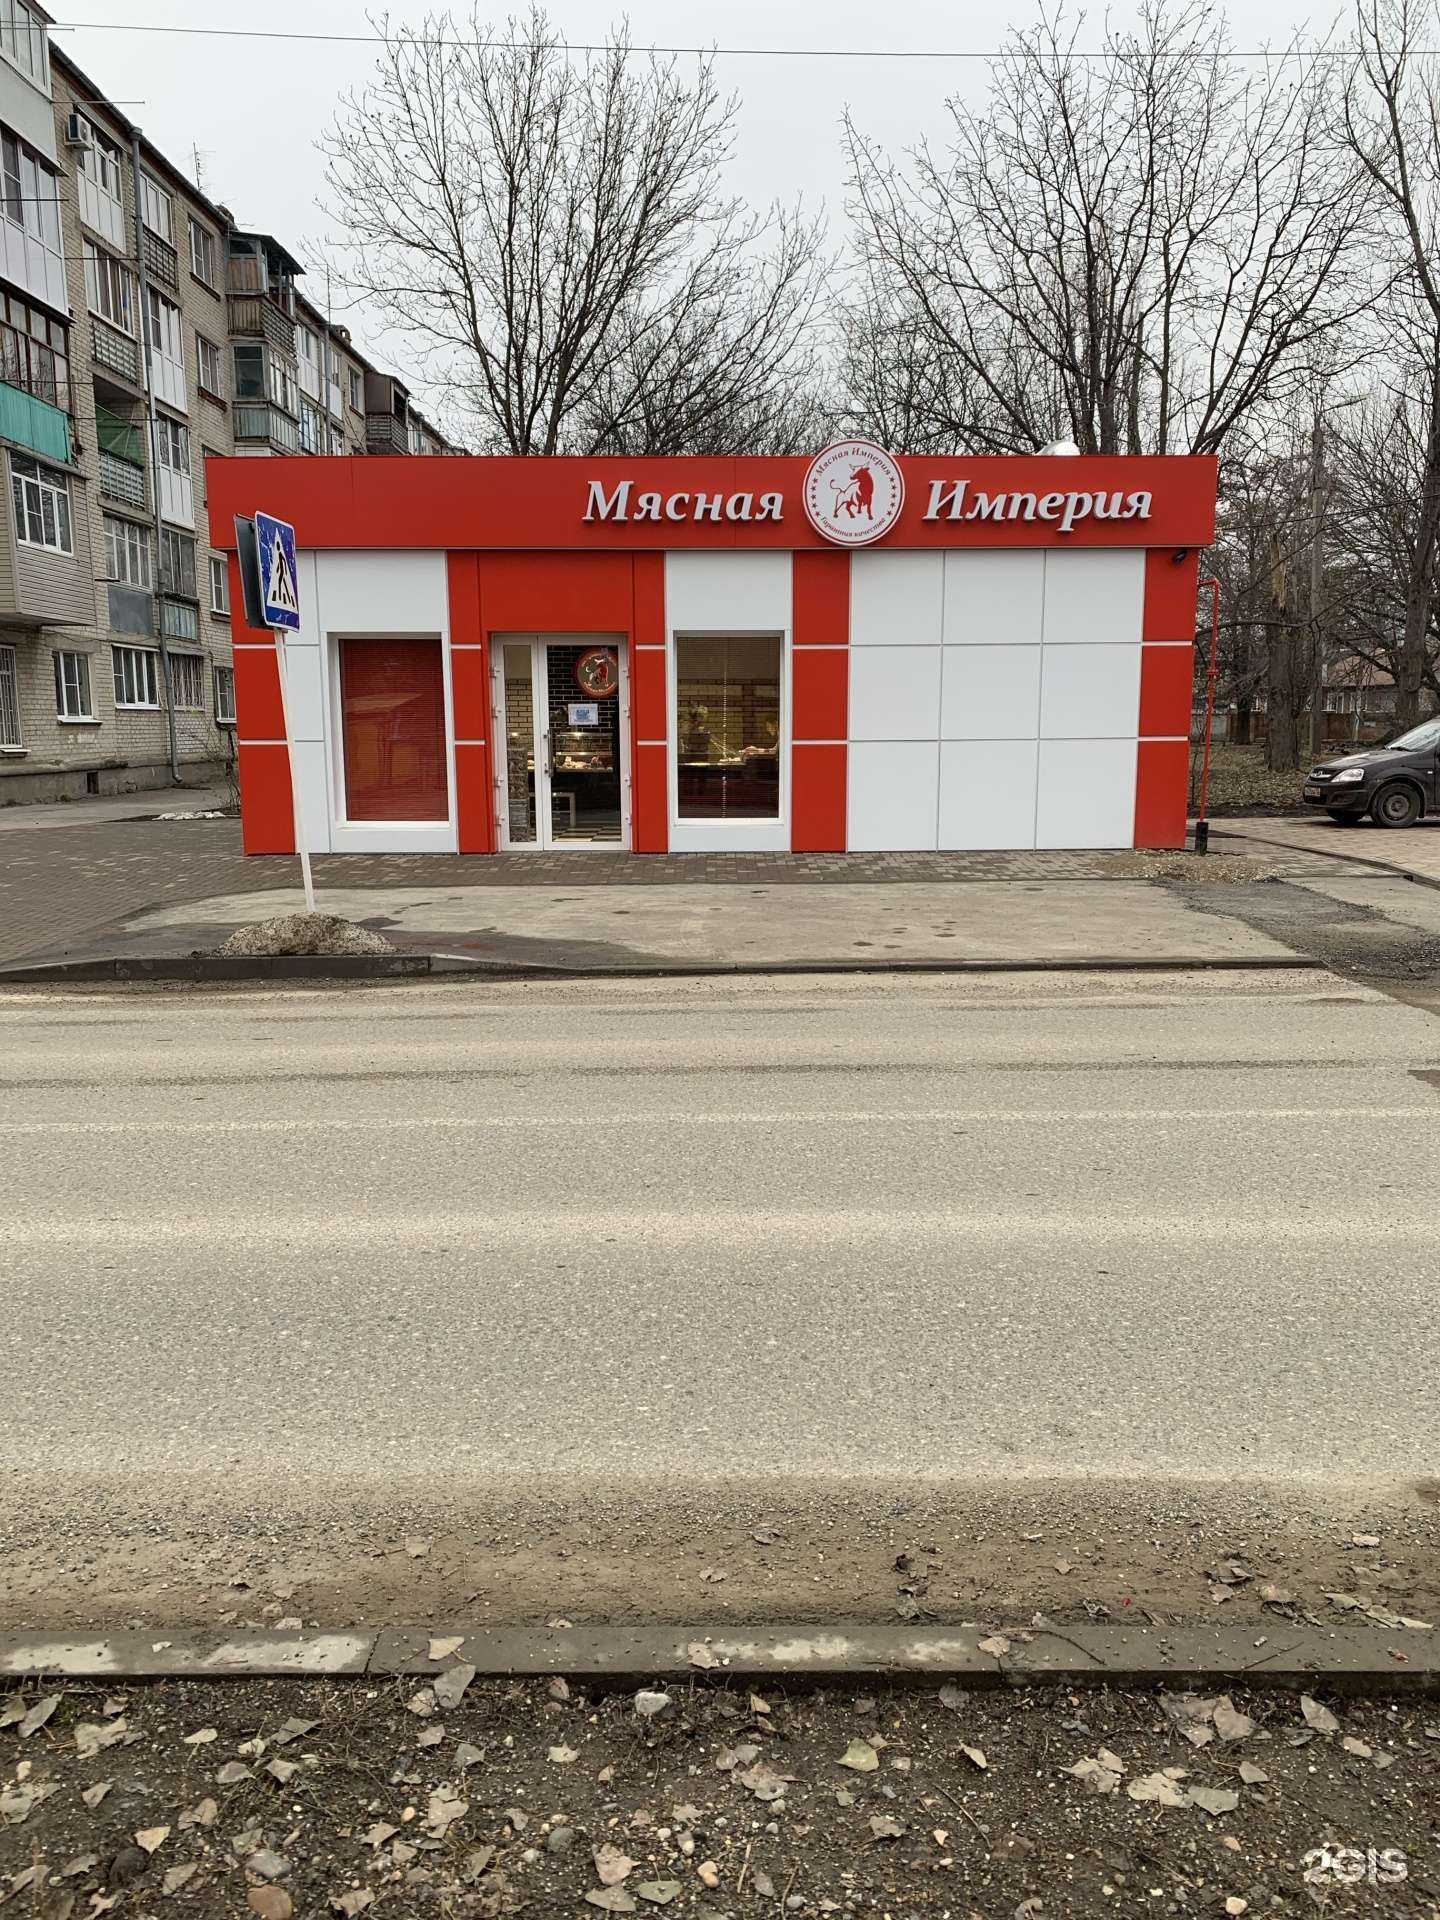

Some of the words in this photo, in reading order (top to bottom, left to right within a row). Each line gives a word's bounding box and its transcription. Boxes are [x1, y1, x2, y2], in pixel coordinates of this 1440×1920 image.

[816, 451, 849, 476] Мясная
[852, 447, 891, 475] Империя
[582, 480, 785, 521] Мясная
[922, 479, 1153, 532] Империя
